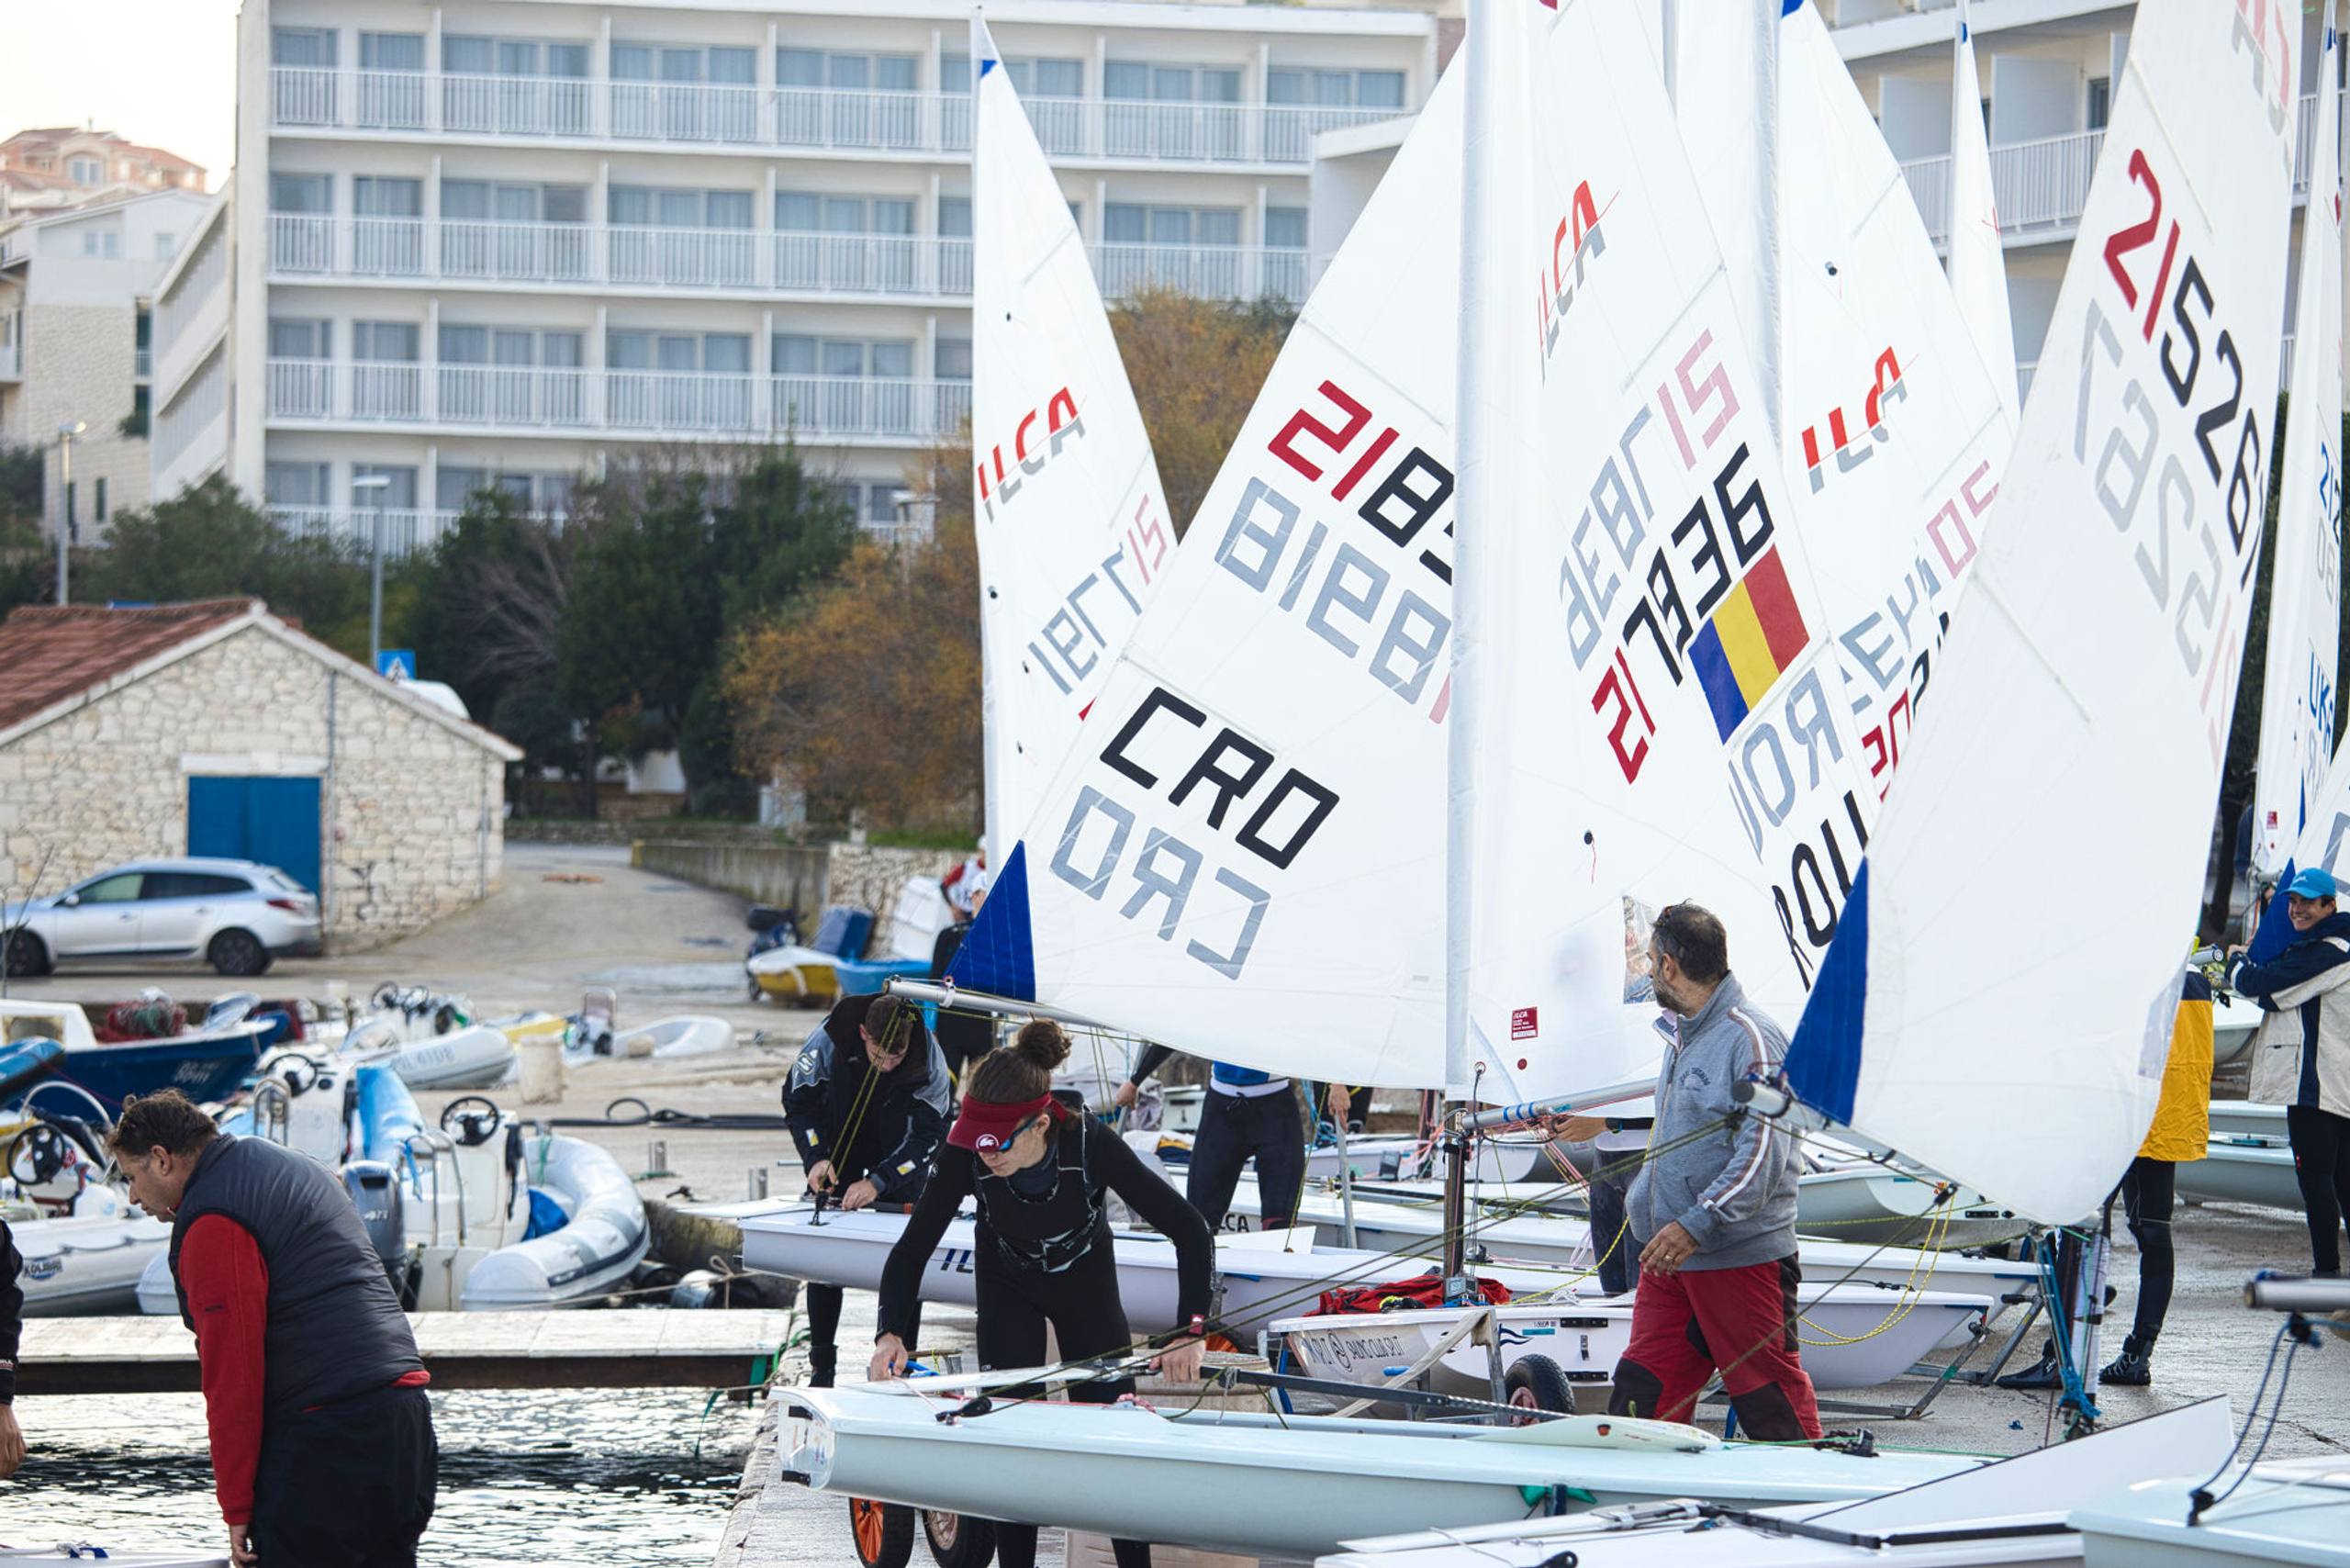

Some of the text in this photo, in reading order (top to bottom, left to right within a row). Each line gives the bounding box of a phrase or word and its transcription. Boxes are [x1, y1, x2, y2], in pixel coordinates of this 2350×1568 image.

[1538, 179, 1608, 388] ILCA
[977, 386, 1087, 522] ILCA
[1267, 380, 1454, 586] 218
[1801, 346, 1908, 495] ILCA
[1100, 687, 1340, 869] CRO
[941, 1249, 973, 1273] IL
[1220, 1214, 1249, 1232] CA
